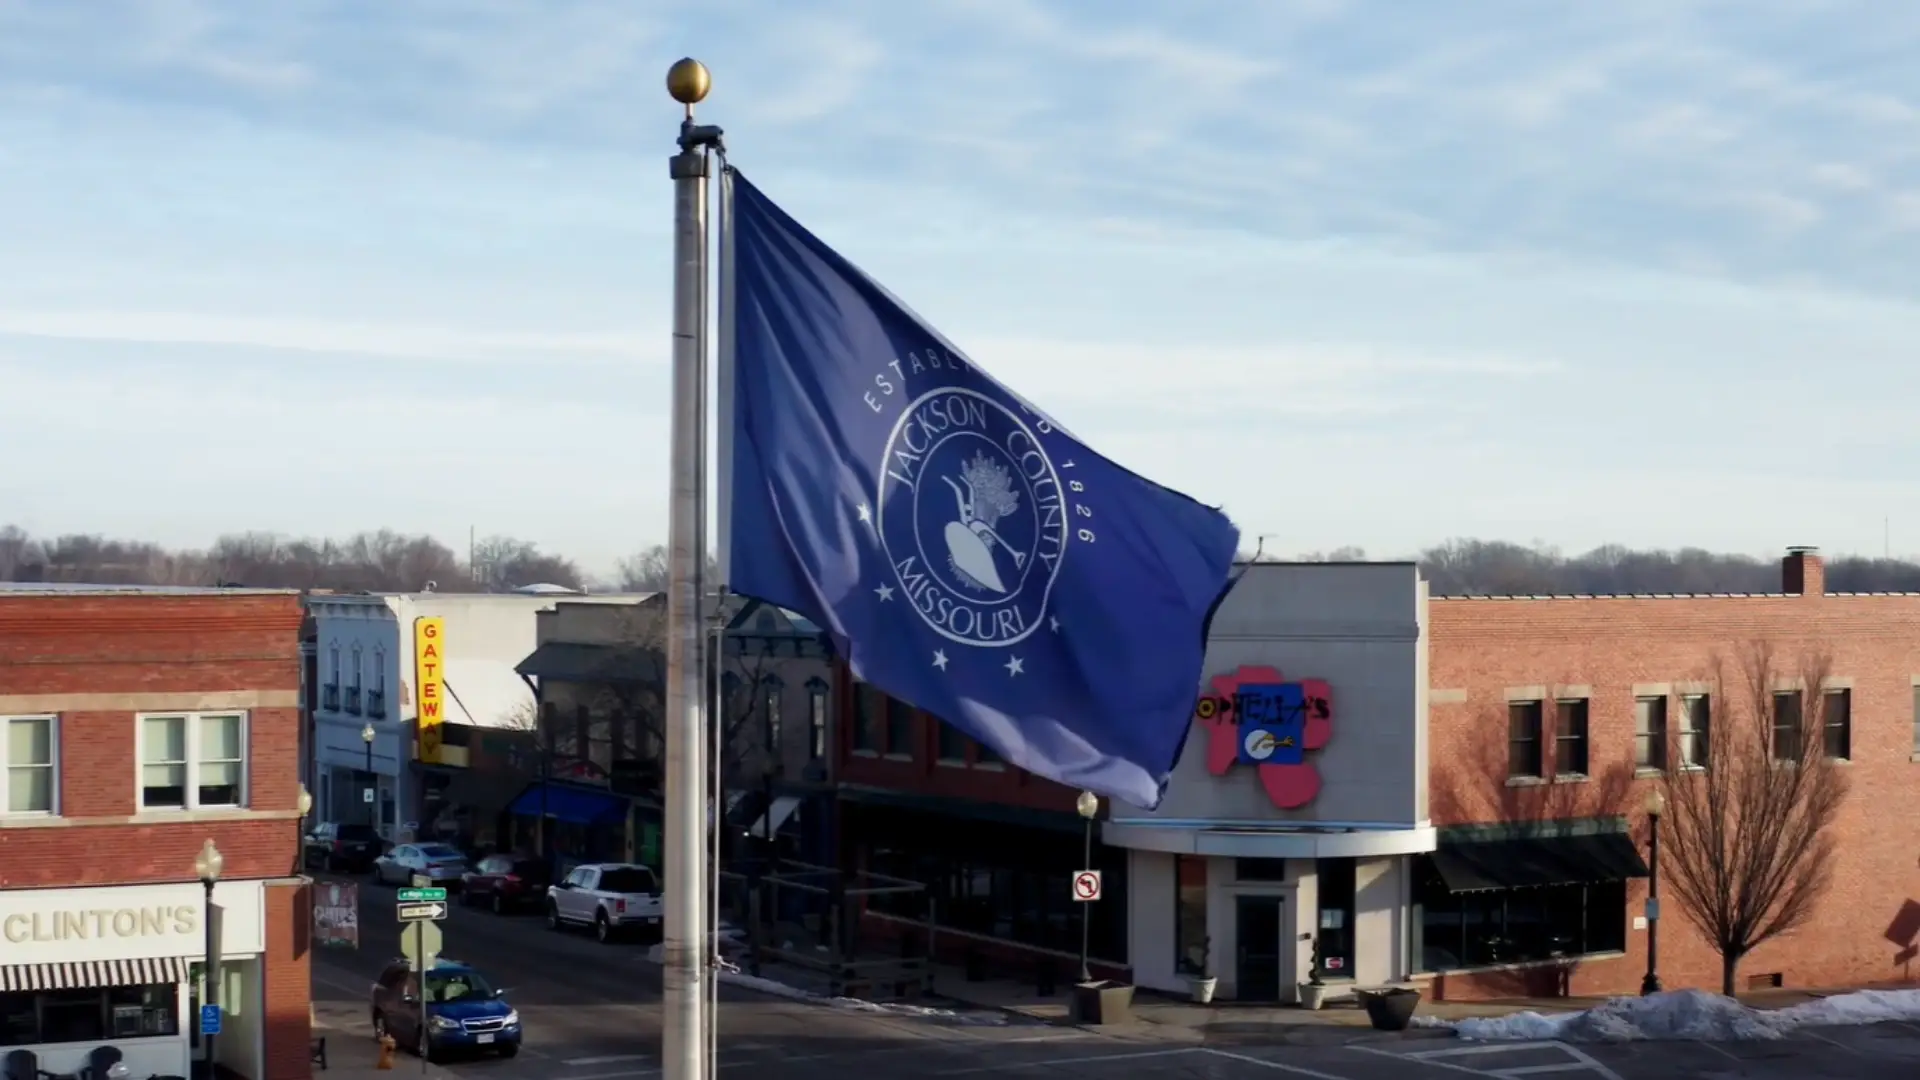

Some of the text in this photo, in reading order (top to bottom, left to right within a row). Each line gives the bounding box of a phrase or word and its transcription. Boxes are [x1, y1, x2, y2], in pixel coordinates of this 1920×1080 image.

[886, 395, 1062, 572] JACKSON COUNTY
[1061, 459, 1096, 544] 1826
[895, 555, 1025, 639] MISSOURI
[422, 624, 438, 755] GATEWAY
[4, 905, 197, 944] CLINTON'S
